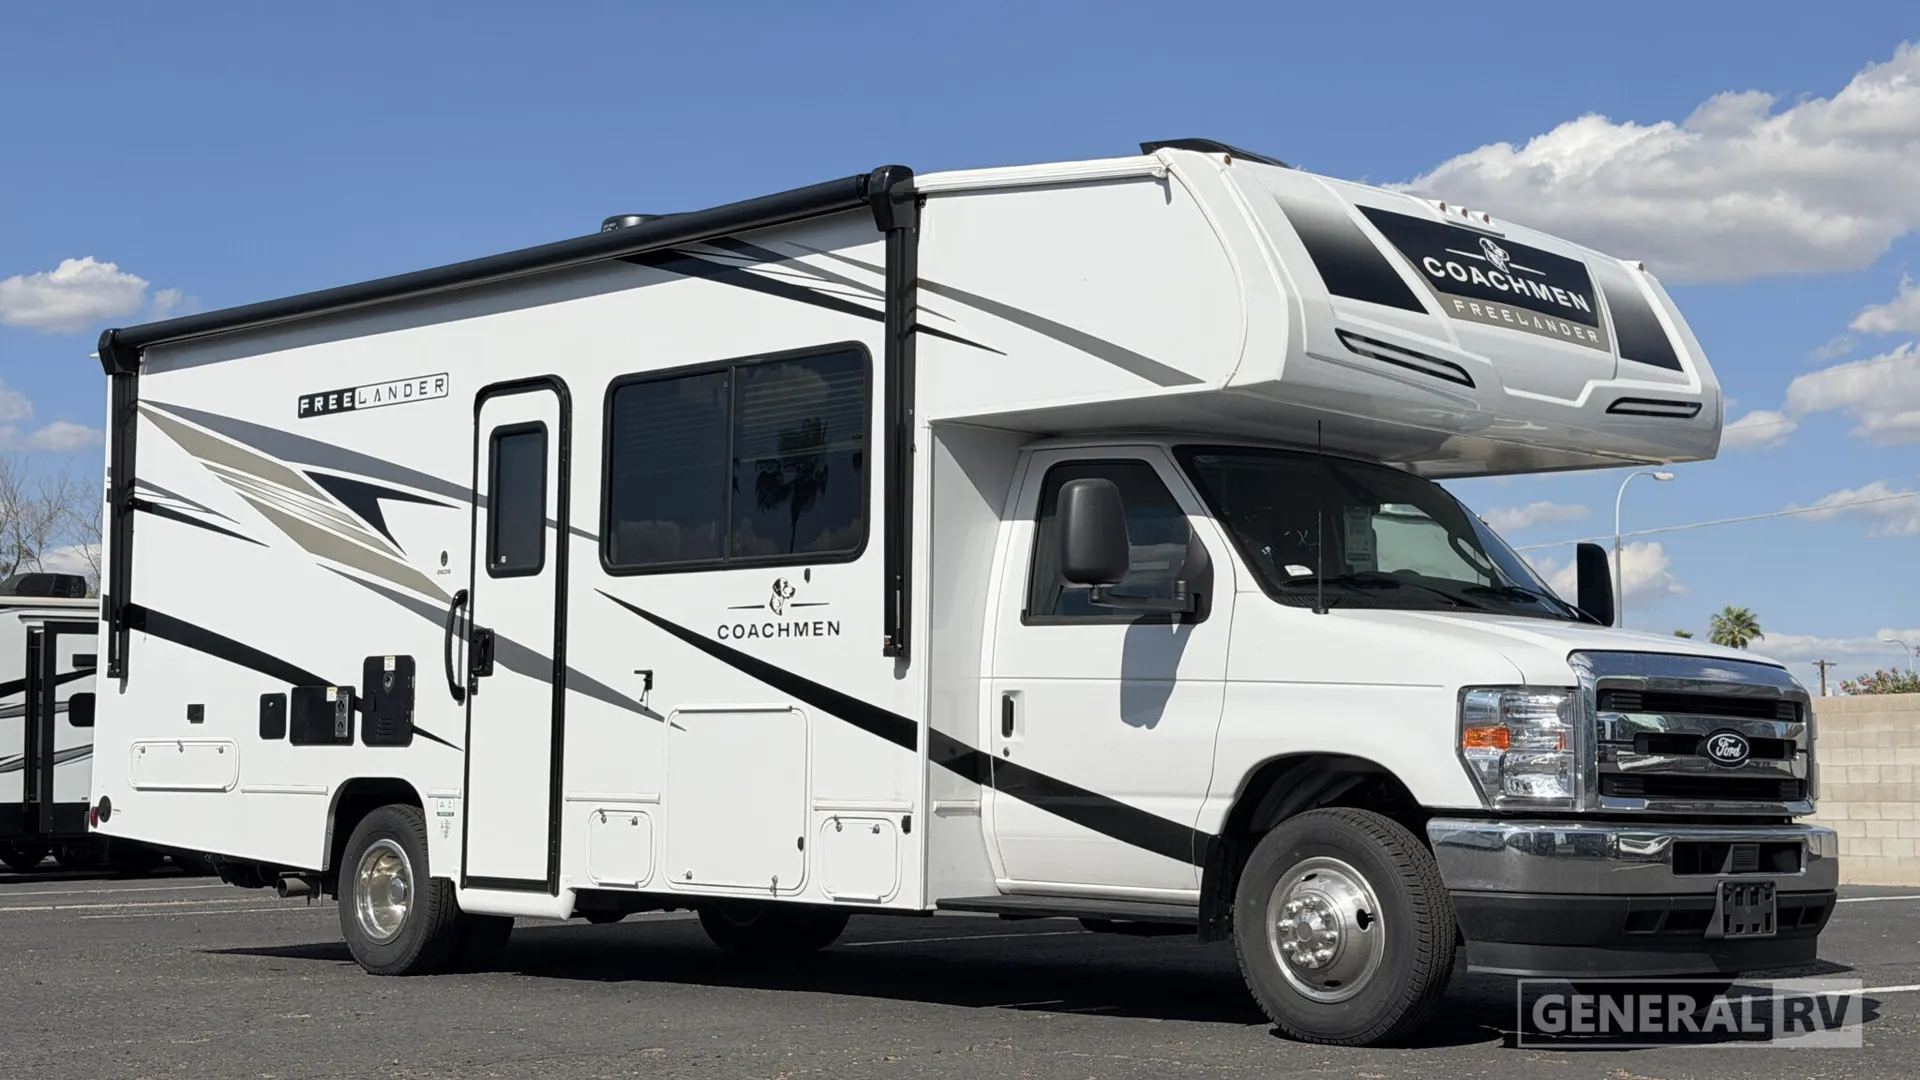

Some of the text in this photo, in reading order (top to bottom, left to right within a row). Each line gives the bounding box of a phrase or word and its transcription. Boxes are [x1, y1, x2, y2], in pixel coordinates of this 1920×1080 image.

[1422, 256, 1591, 313] COACHMEN
[1453, 299, 1599, 343] FREELANDER
[300, 378, 444, 414] FREELANDER
[717, 620, 840, 639] COACHMEN
[1716, 737, 1742, 758] Ford
